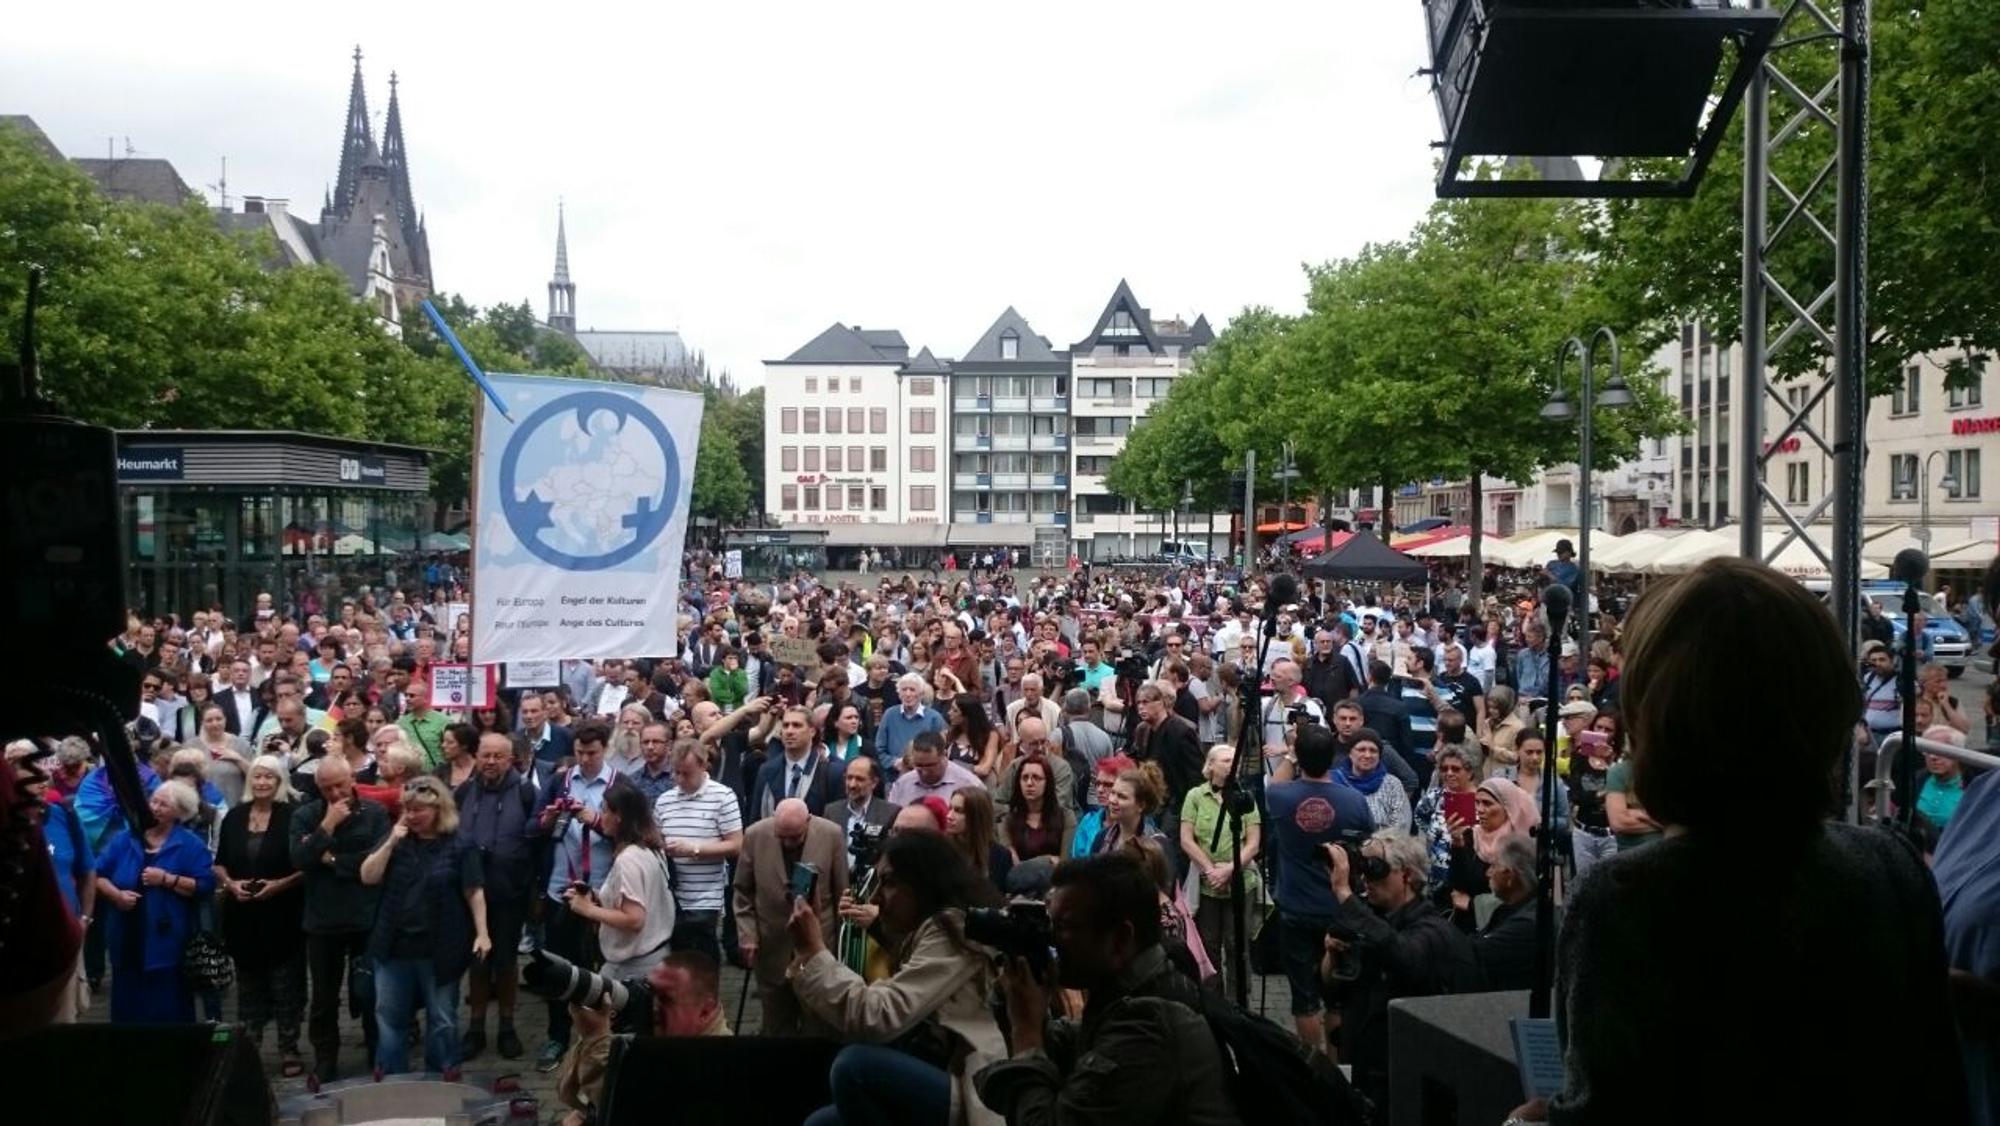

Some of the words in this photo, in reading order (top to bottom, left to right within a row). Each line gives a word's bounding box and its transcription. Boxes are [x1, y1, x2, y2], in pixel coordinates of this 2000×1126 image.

[116, 457, 178, 471] Heumarkt
[560, 595, 587, 606] Engel
[589, 596, 605, 605] der
[606, 596, 646, 605] Kulturen
[559, 619, 584, 629] Ange
[586, 619, 603, 627] des
[604, 618, 645, 627] Cultures
